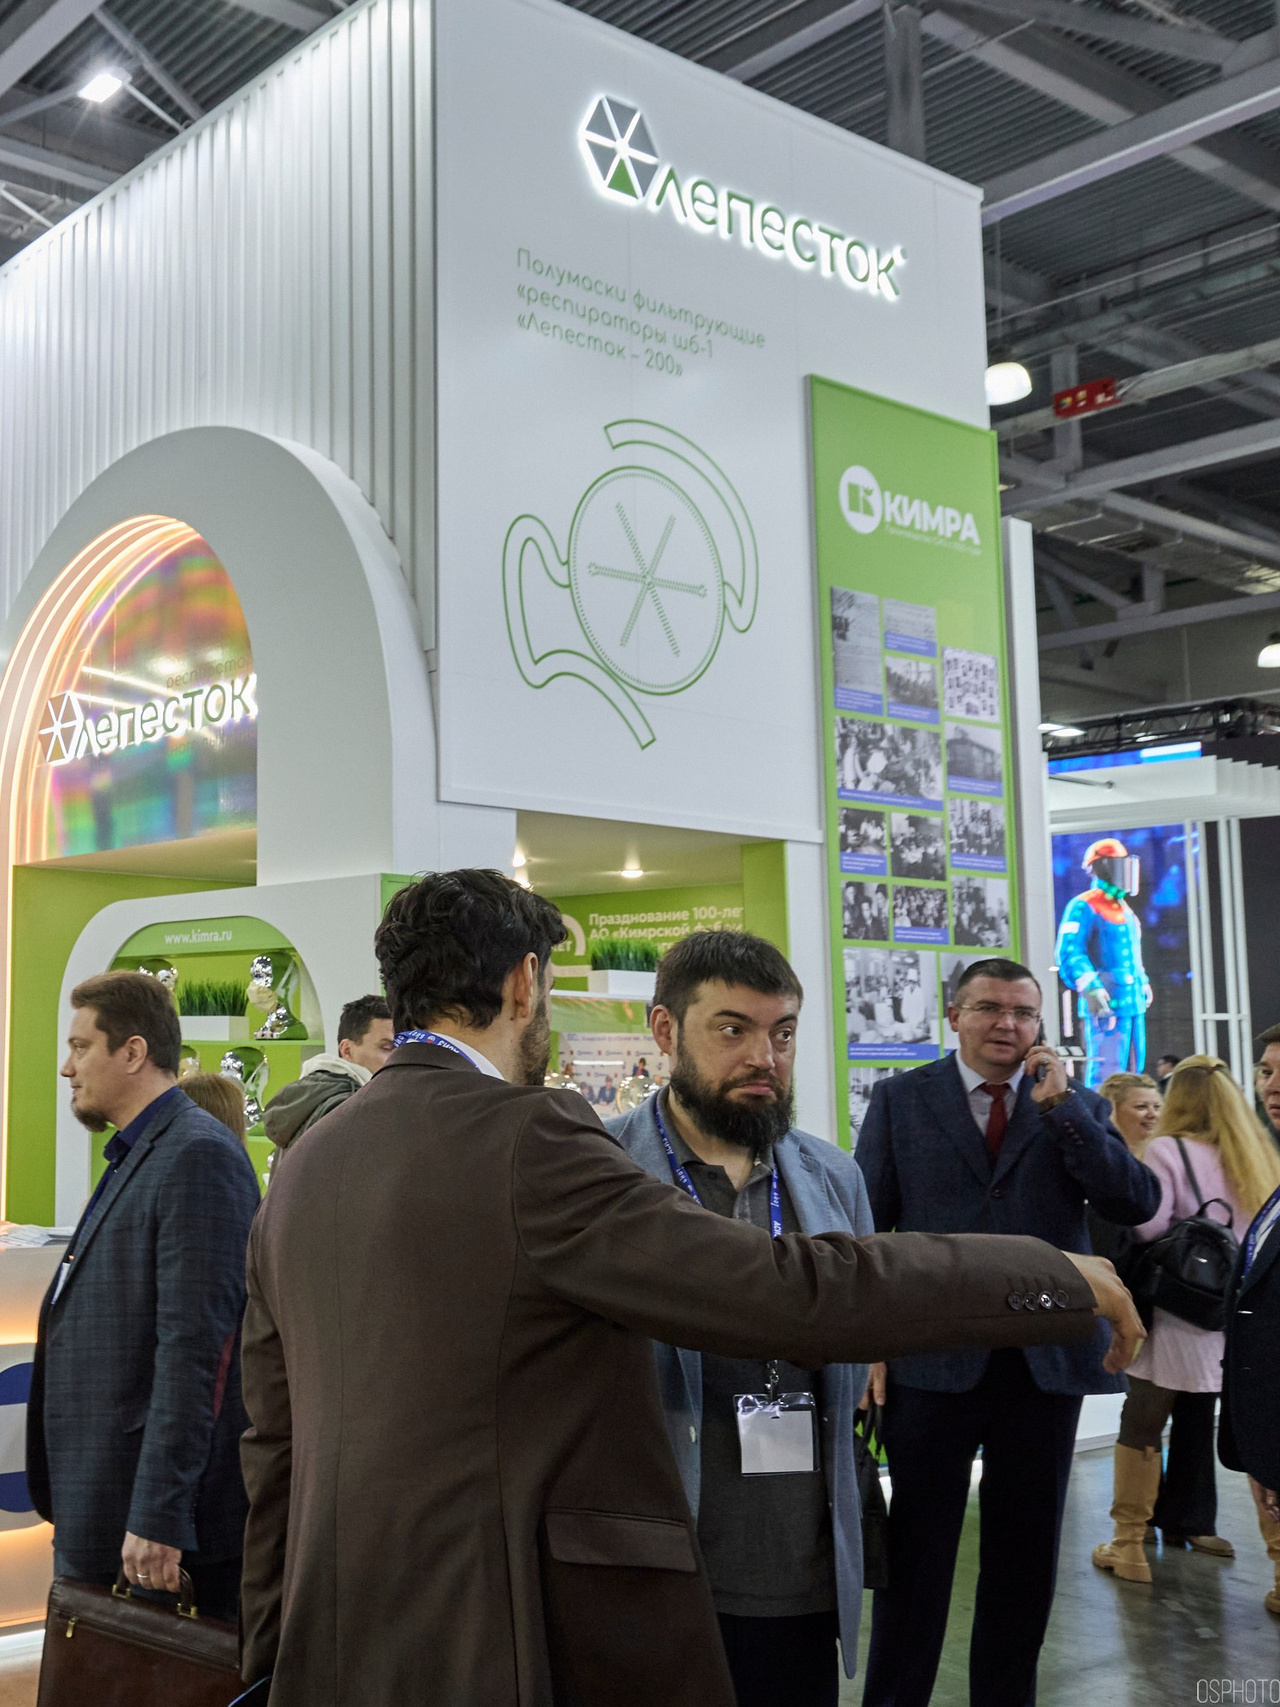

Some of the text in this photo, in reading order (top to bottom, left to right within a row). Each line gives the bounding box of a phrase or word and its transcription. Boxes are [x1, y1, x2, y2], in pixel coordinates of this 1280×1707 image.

[516, 283, 668, 343] «респираторы
[517, 248, 767, 348] Полумаски фильтрующие
[516, 311, 626, 360] «Лепесток
[645, 348, 684, 377] 200»
[883, 490, 981, 546] КИМРА
[164, 928, 232, 944] www.kimra.ru
[589, 909, 690, 928] Празднование
[612, 922, 690, 941] «Кимрской
